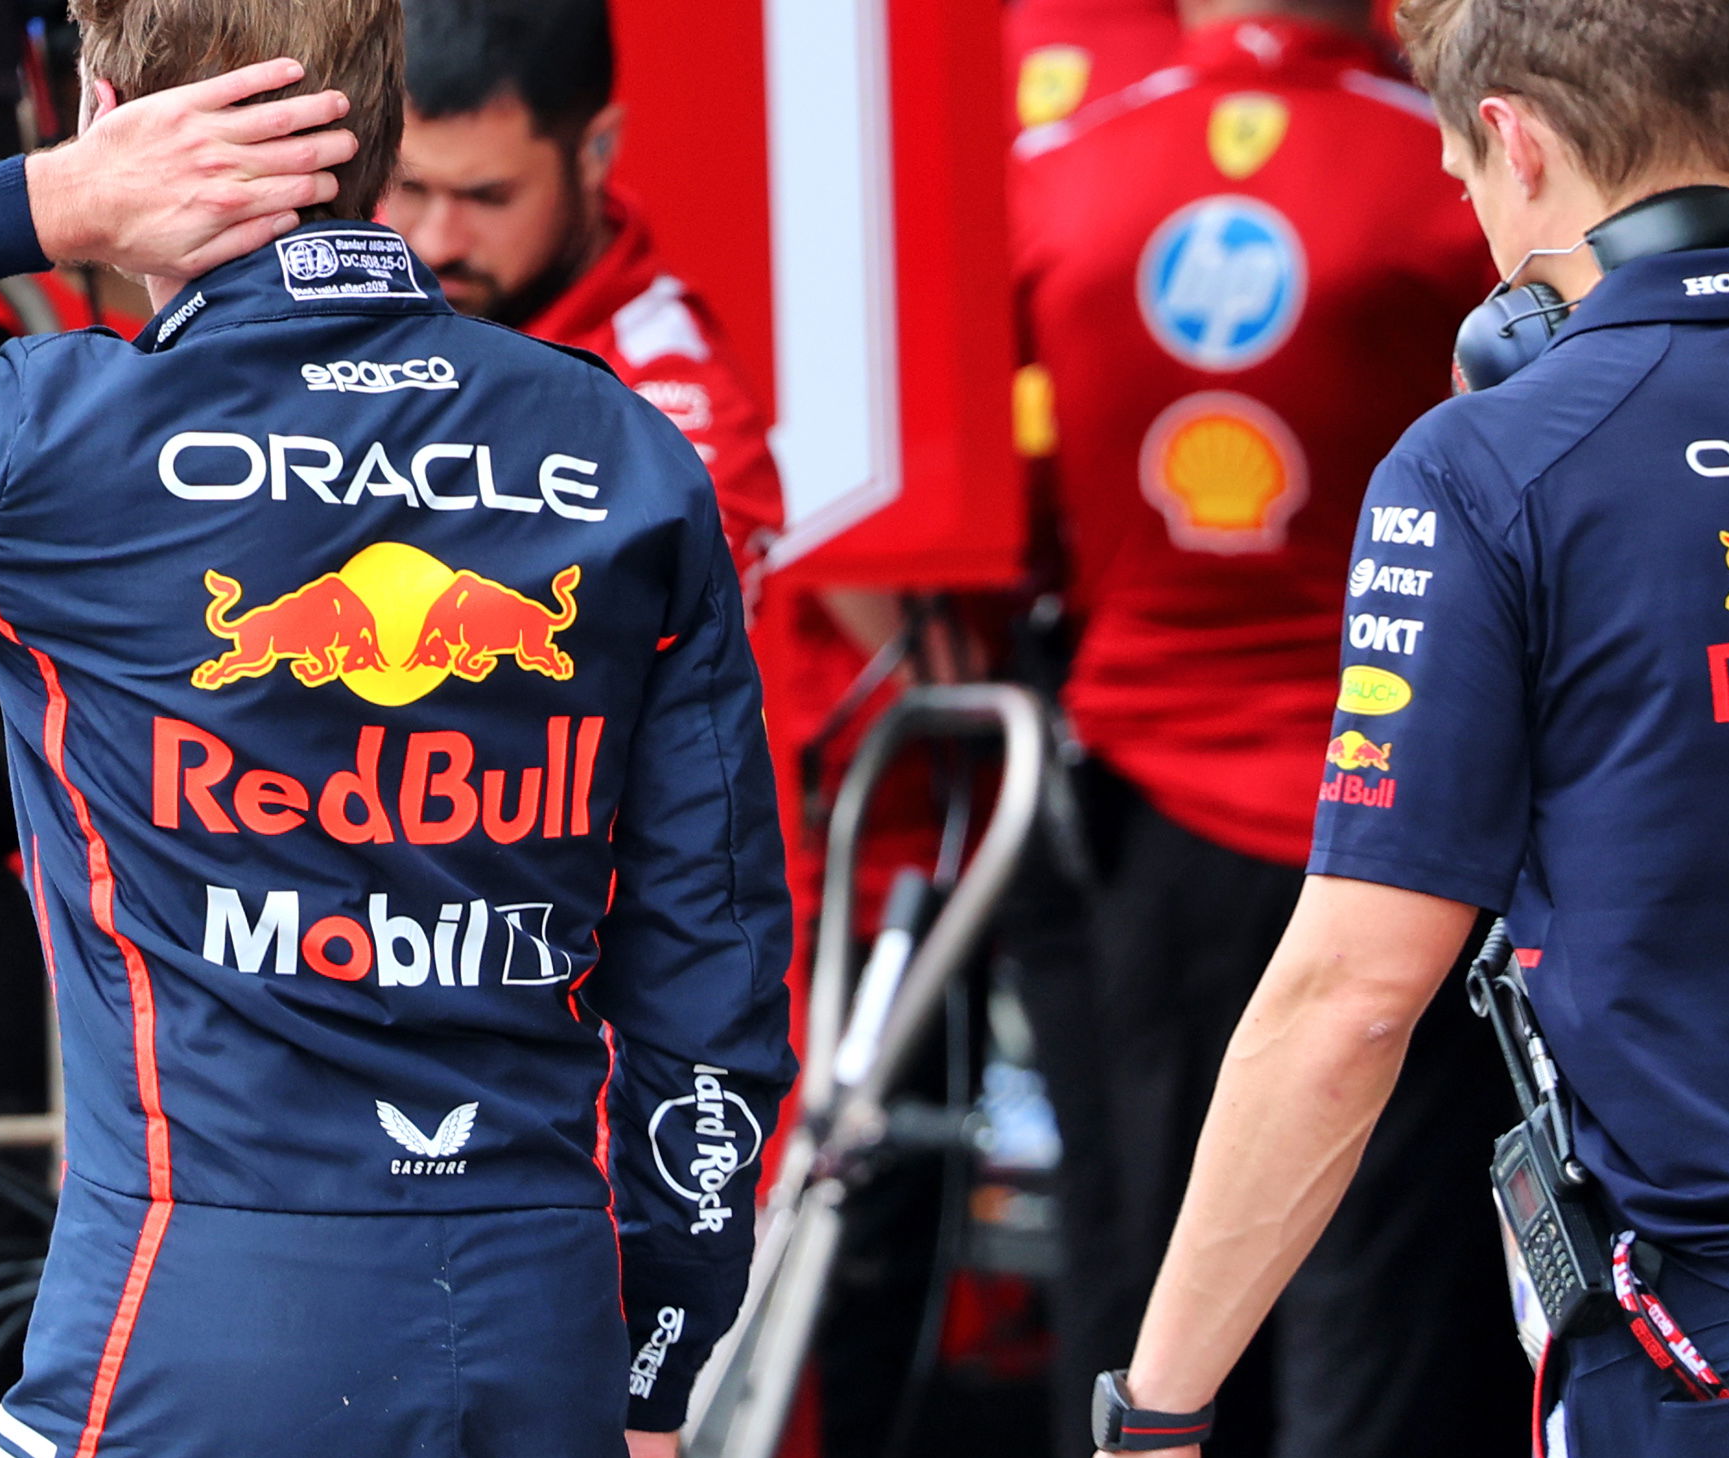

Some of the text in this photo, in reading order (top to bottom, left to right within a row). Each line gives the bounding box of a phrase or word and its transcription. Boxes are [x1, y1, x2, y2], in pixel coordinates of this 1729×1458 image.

[288, 245, 334, 274] FIA
[155, 291, 207, 347] assword
[301, 356, 458, 393] sparco
[158, 430, 608, 523] ORACLE
[1371, 506, 1437, 547] VISA
[1370, 565, 1433, 597] AT&T
[1348, 613, 1424, 655] OKT
[203, 884, 488, 987] Mobil
[390, 1158, 467, 1175] CASTORE
[628, 1305, 685, 1399] sparco
